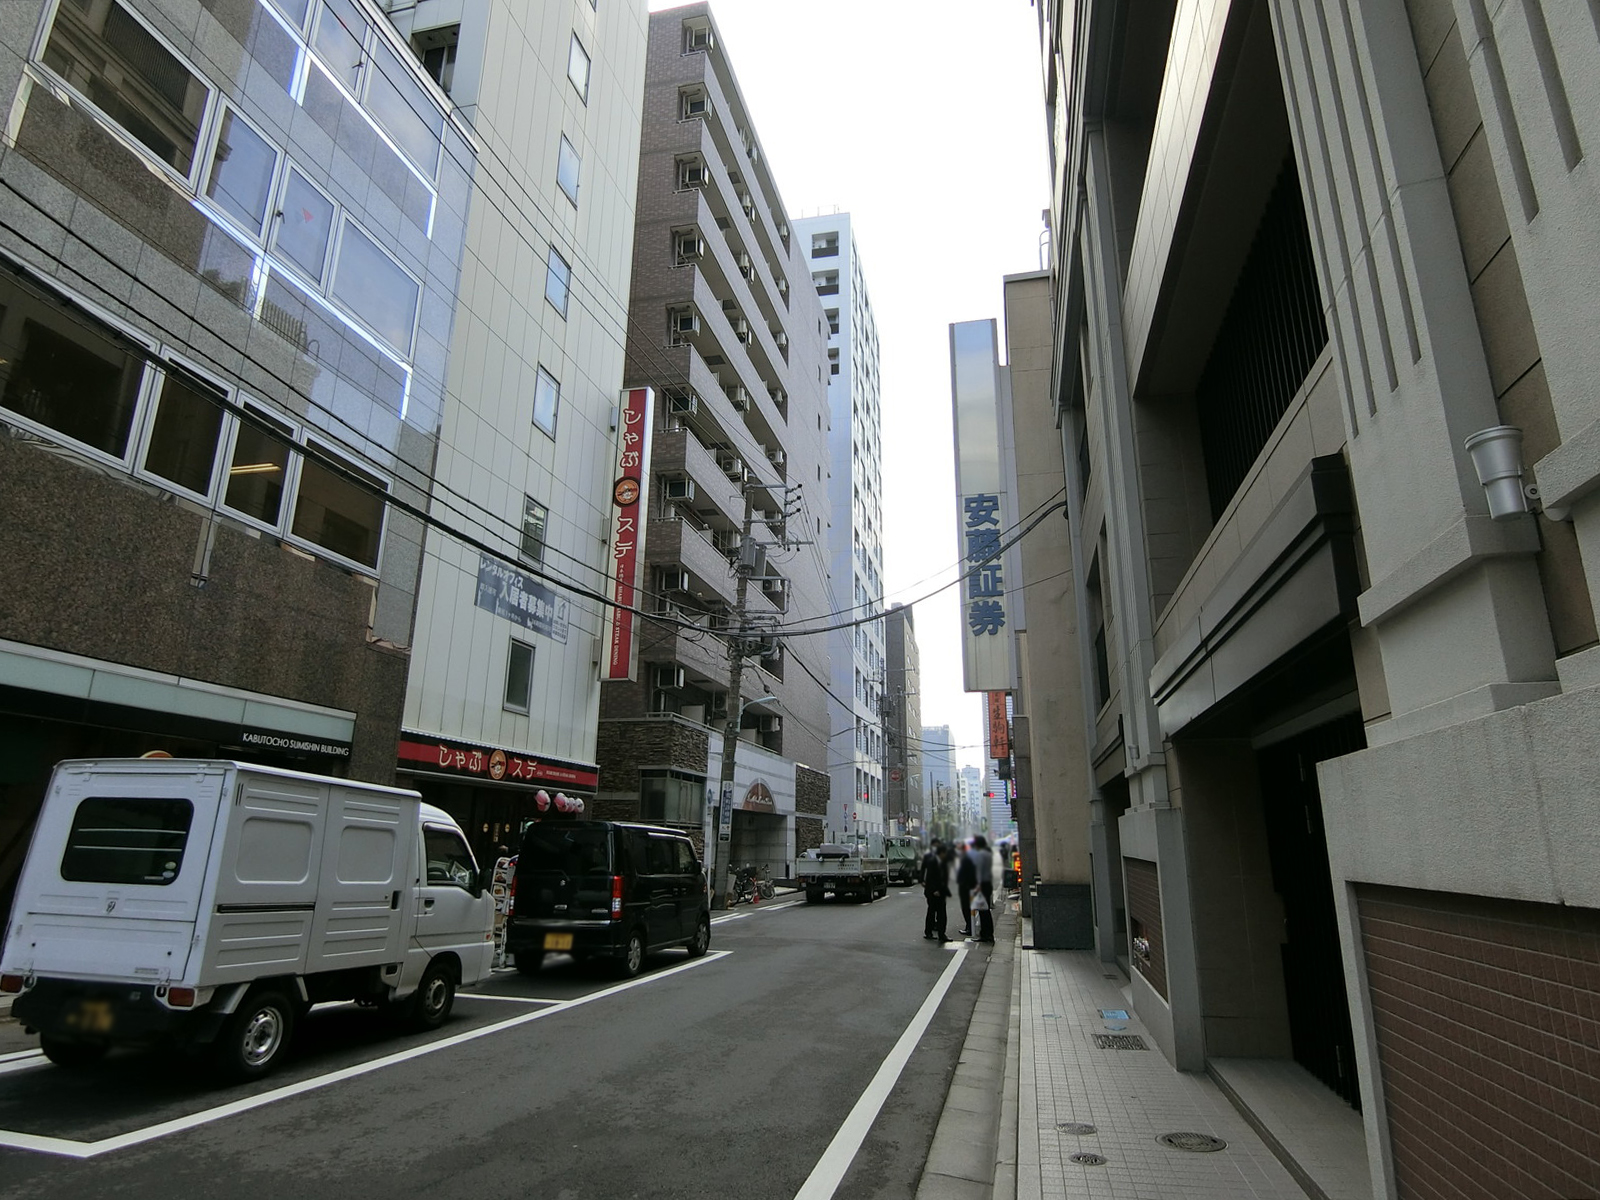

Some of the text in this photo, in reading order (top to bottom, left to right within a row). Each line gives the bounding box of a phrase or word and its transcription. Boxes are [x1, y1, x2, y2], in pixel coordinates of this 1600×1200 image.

[615, 409, 642, 559] しゃぶ ステ
[480, 557, 524, 589] レンタルオフィス
[963, 493, 1005, 637] 安藤証券
[499, 580, 554, 622] 入居者募集中
[243, 733, 350, 756] KABUTOCHO SUMISHIN BUILDING
[438, 745, 482, 772] しゃぶ
[512, 758, 538, 779] ステ
